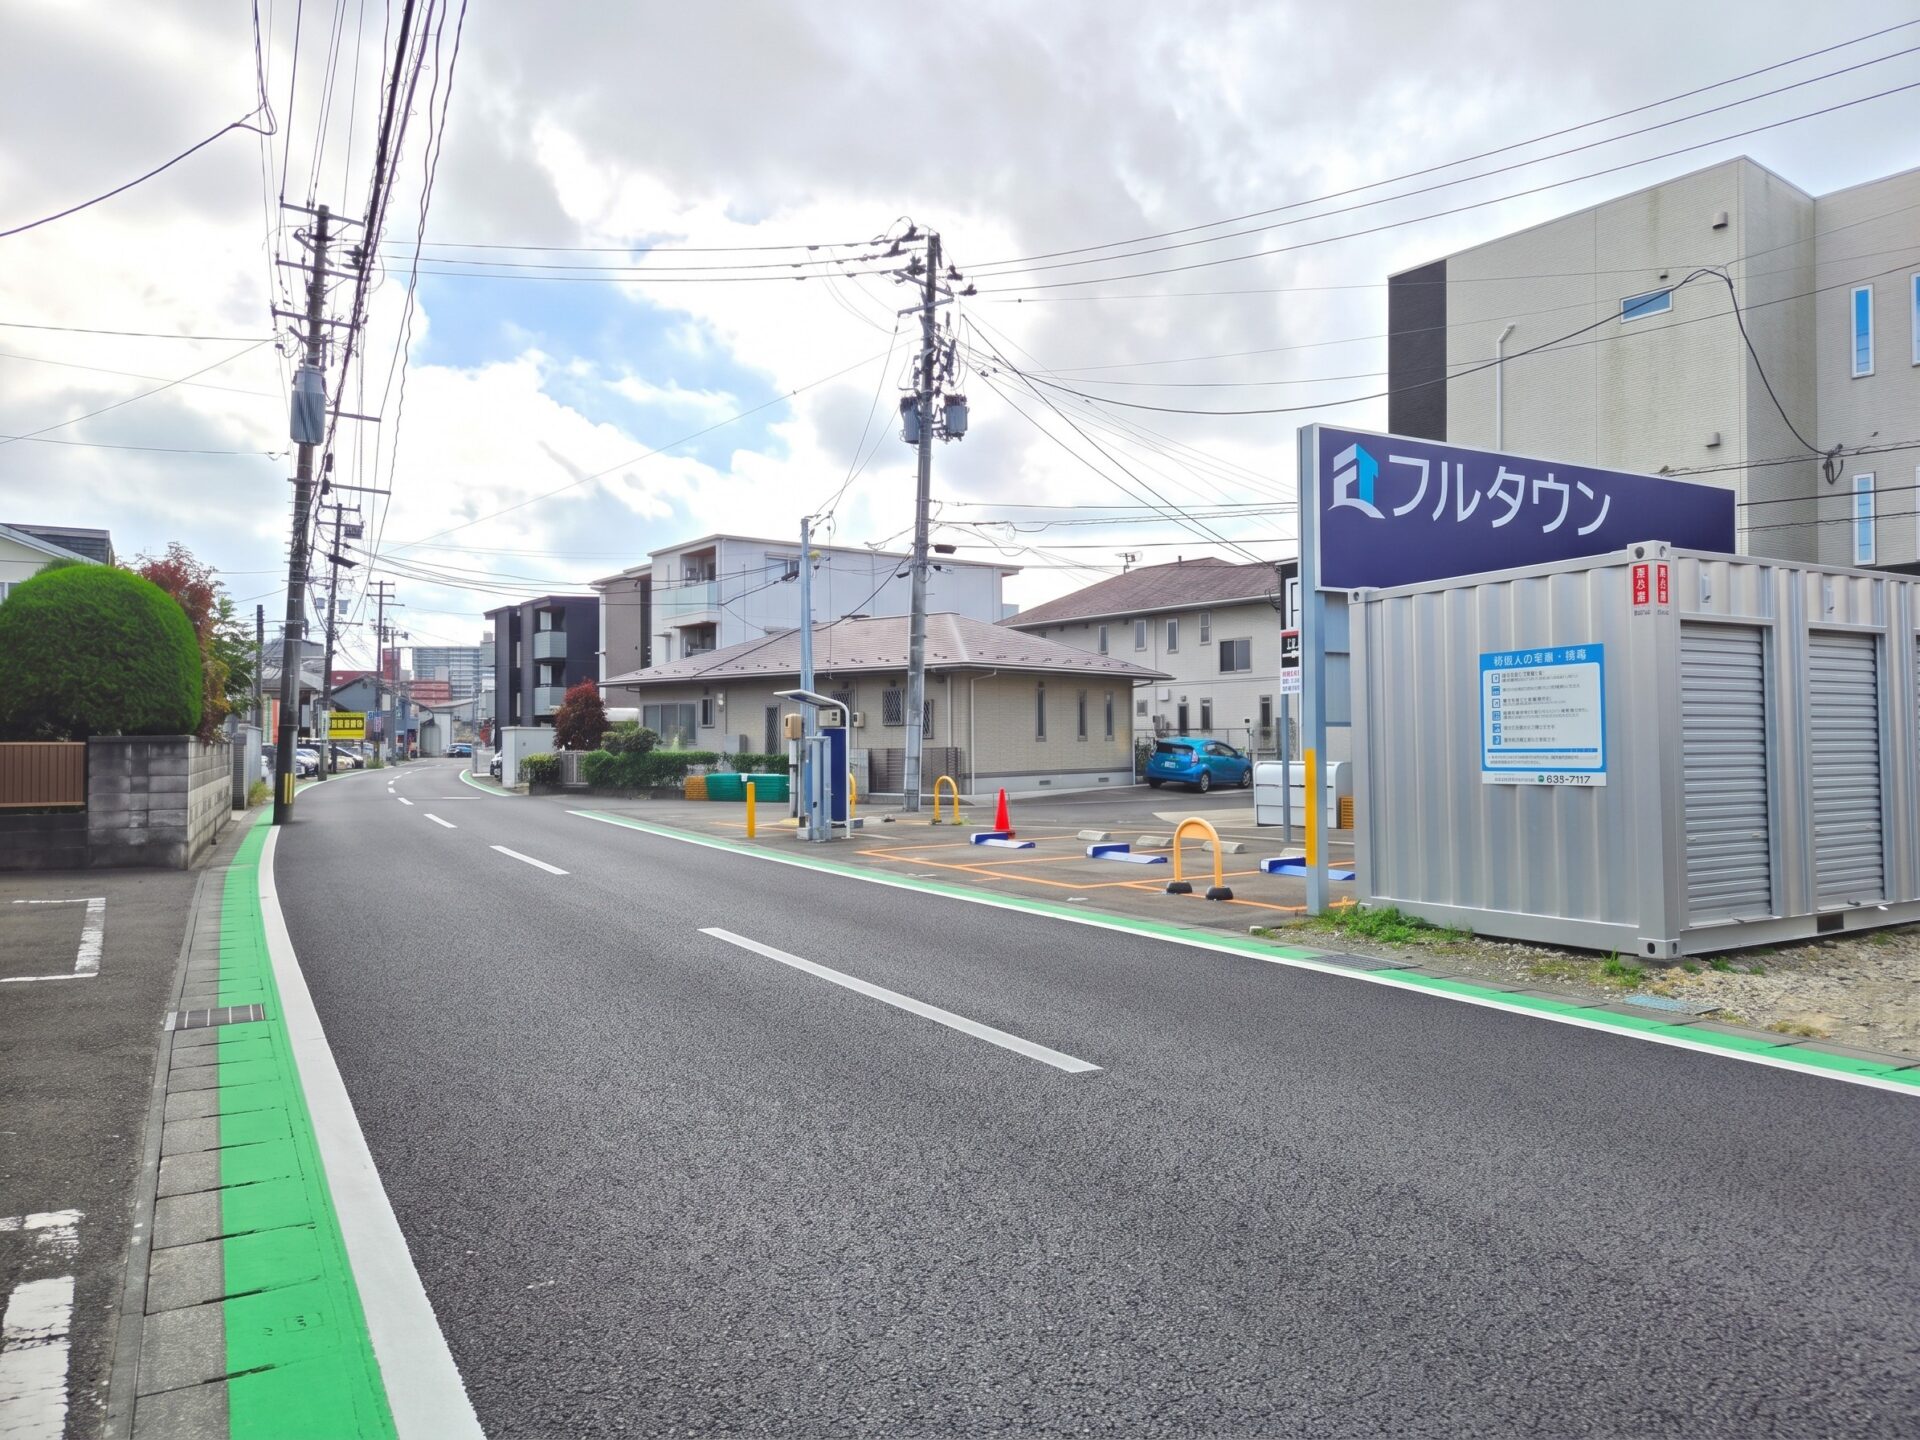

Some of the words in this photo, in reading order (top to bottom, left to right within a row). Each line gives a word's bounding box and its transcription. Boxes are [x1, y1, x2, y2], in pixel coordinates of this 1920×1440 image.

[1389, 455, 1611, 536] フルタウン
